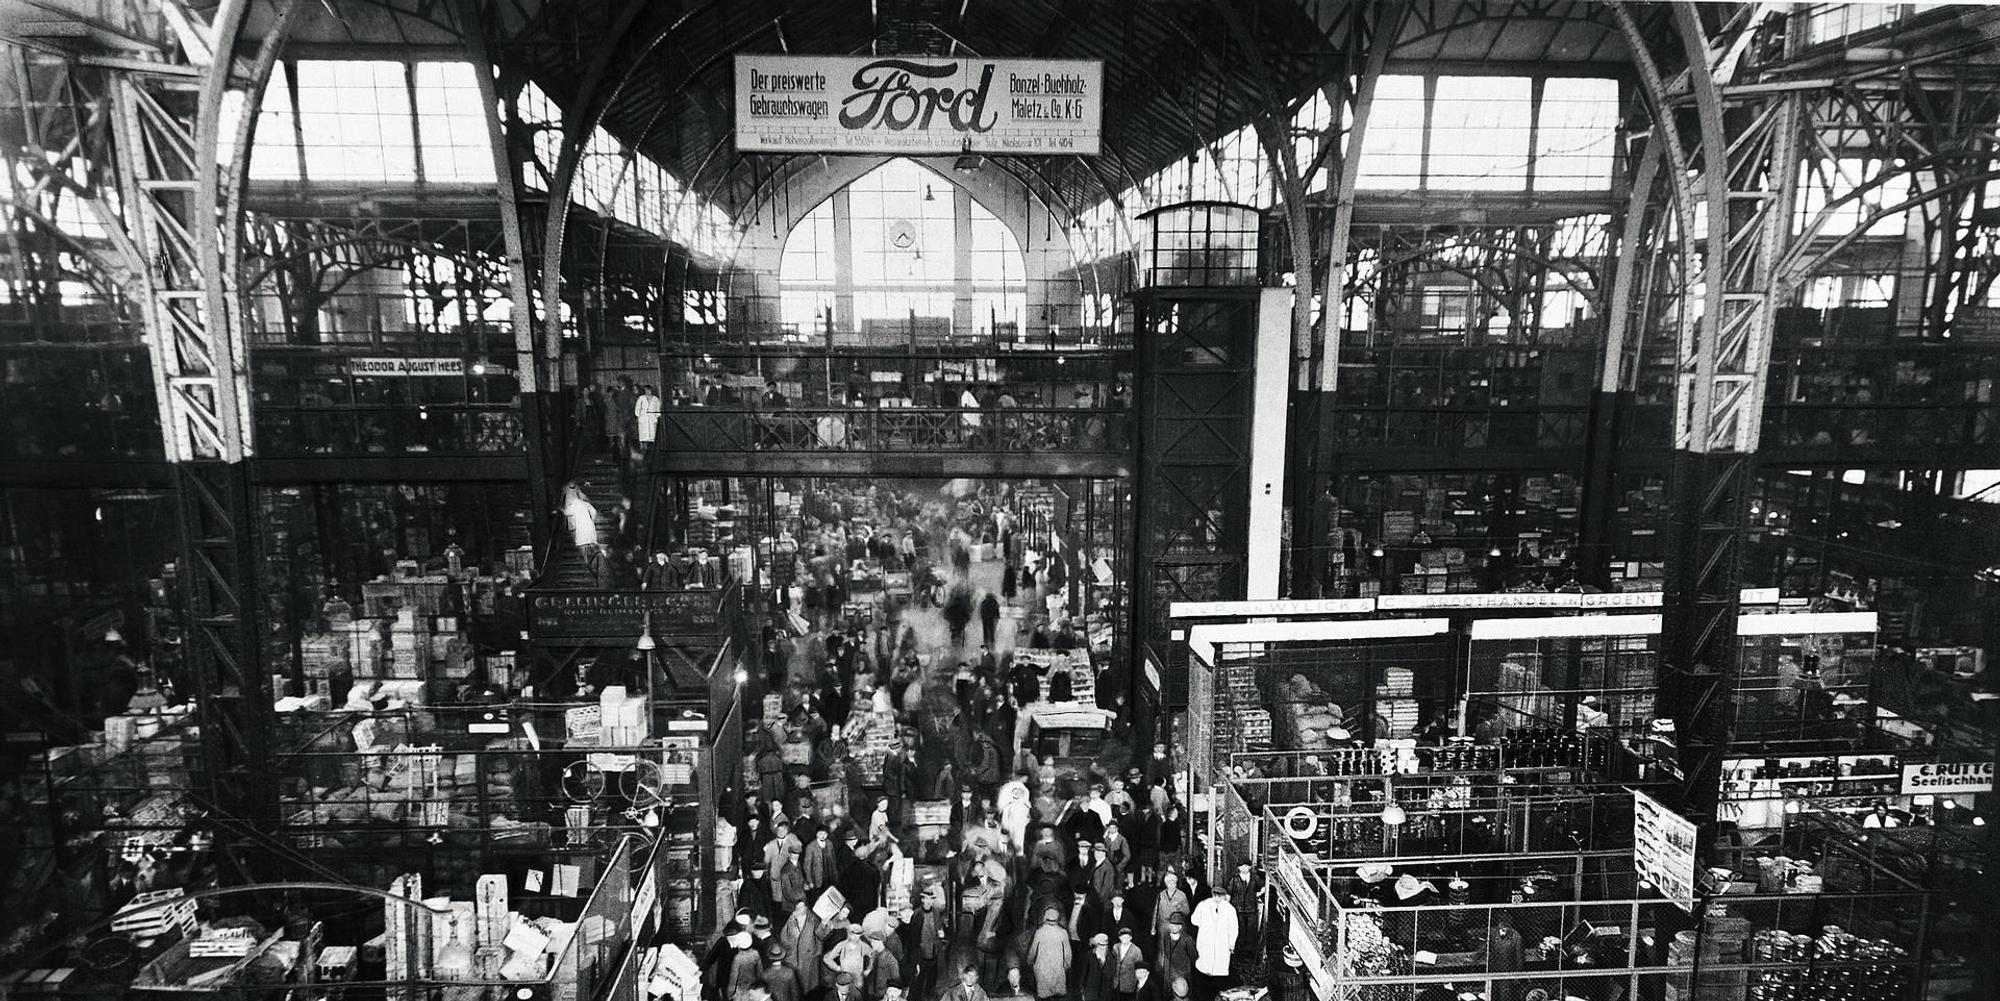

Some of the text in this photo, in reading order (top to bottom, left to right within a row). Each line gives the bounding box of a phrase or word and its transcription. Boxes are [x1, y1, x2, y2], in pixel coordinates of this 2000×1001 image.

[751, 69, 826, 93] Der preiswerte
[838, 59, 998, 133] Ford
[750, 95, 829, 120] Gebrauchswagen
[1011, 98, 1042, 119] Maletz
[351, 361, 395, 372] THEODOR
[438, 361, 463, 372] HEES
[1268, 600, 1350, 613] WYLICK
